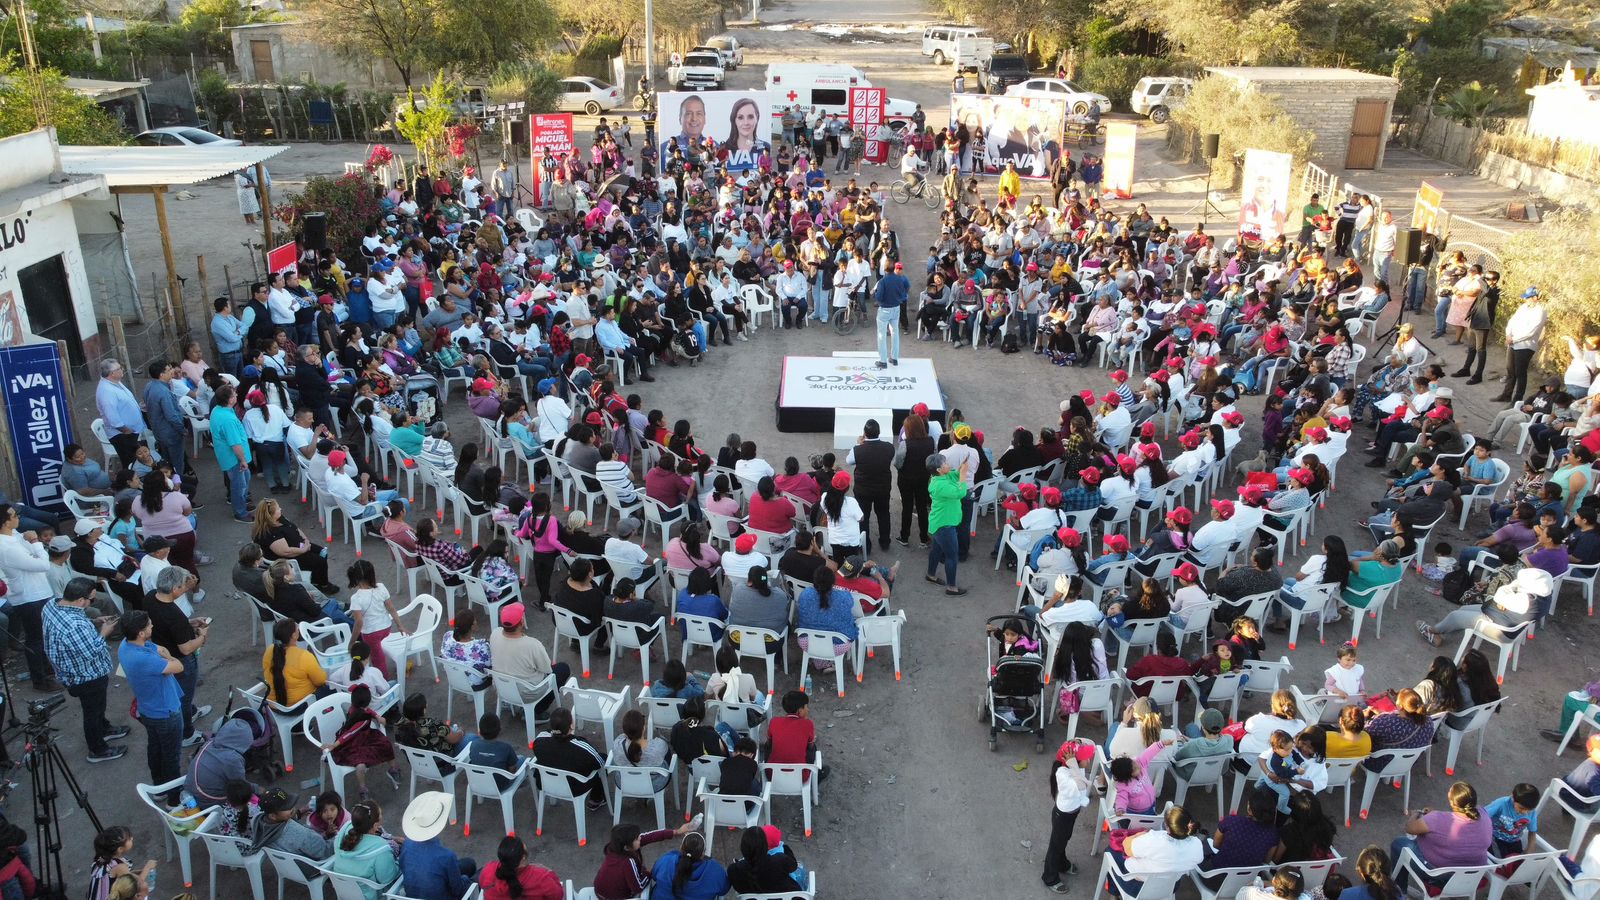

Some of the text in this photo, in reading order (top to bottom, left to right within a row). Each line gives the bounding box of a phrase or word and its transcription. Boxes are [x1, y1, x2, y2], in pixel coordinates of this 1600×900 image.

[536, 135, 568, 143] MIGUEL
[687, 334, 698, 347] 19
[11, 373, 53, 393] ¡VA!
[27, 396, 65, 508] Lilly Téllez
